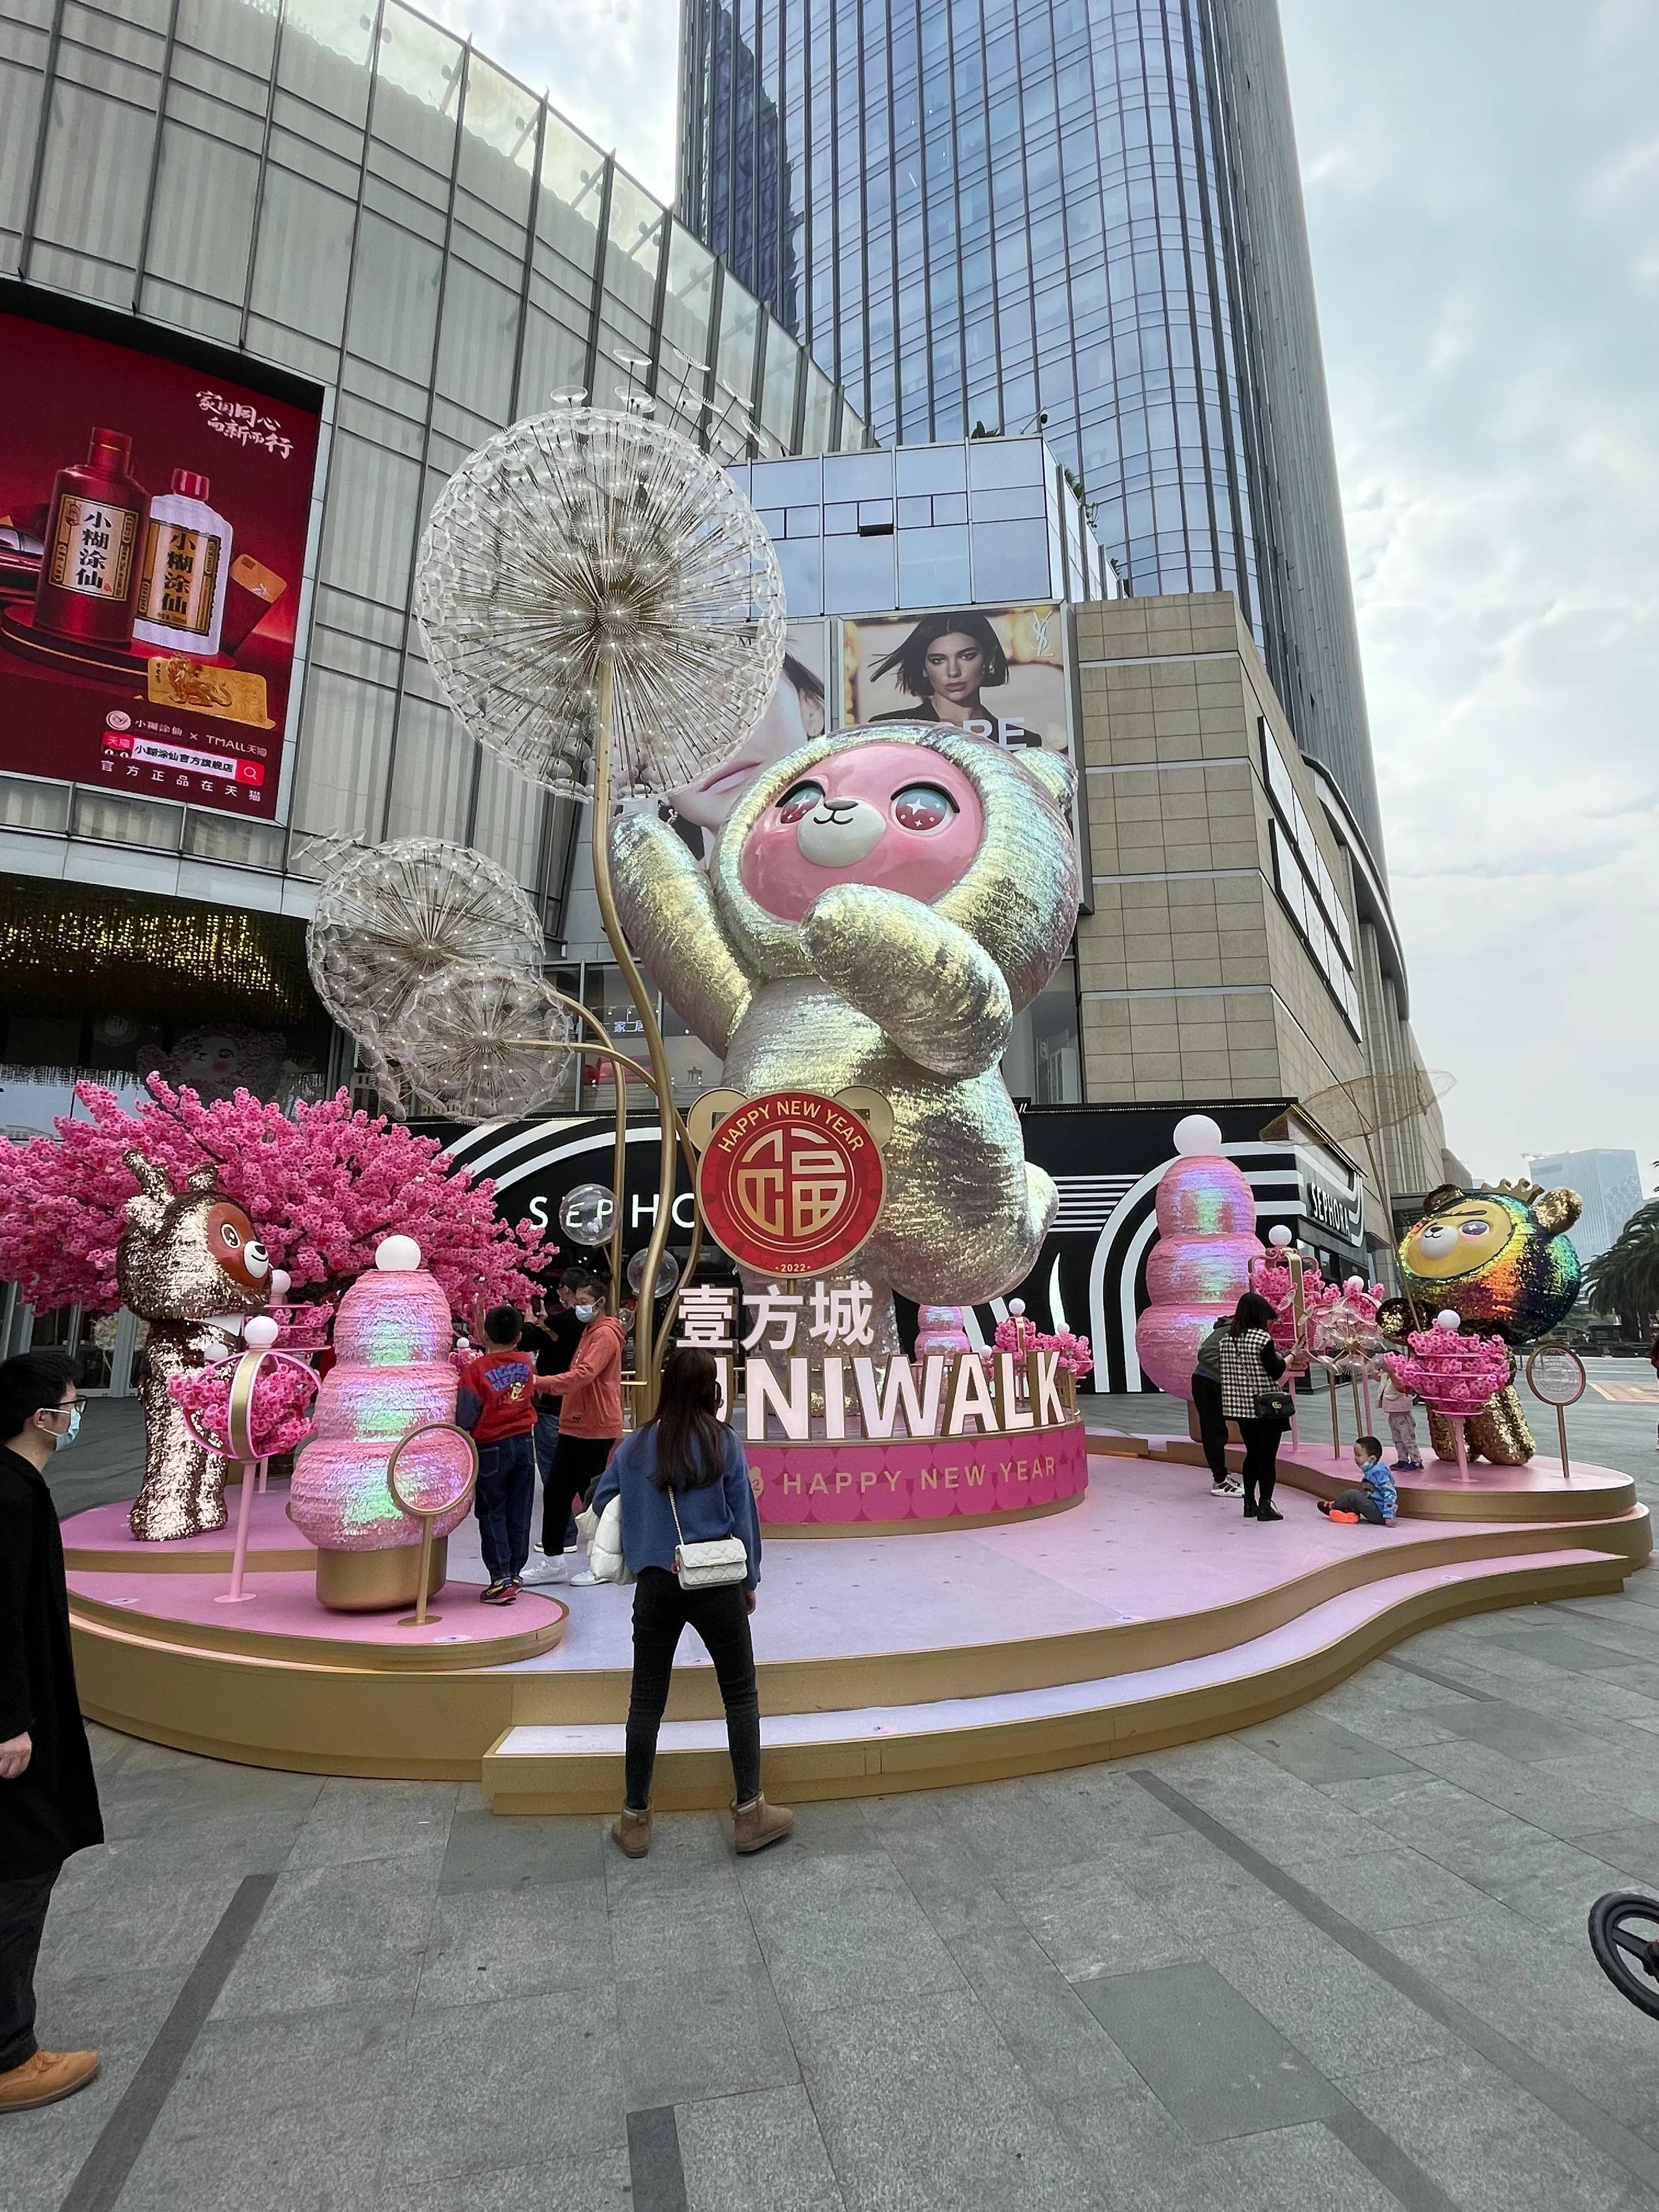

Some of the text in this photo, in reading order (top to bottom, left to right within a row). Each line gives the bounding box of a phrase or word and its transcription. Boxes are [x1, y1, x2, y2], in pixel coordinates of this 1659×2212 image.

[75, 511, 112, 589] 小糊涂仙
[161, 533, 196, 614] 小糊涂仙
[718, 1100, 865, 1153] HAPPY NEW YEAR
[1311, 1182, 1351, 1237] SEPHORA
[780, 1263, 806, 1272] 2022
[676, 1280, 874, 1350] 壹方城
[783, 1455, 1055, 1495] HAPPY NEW YEAR
